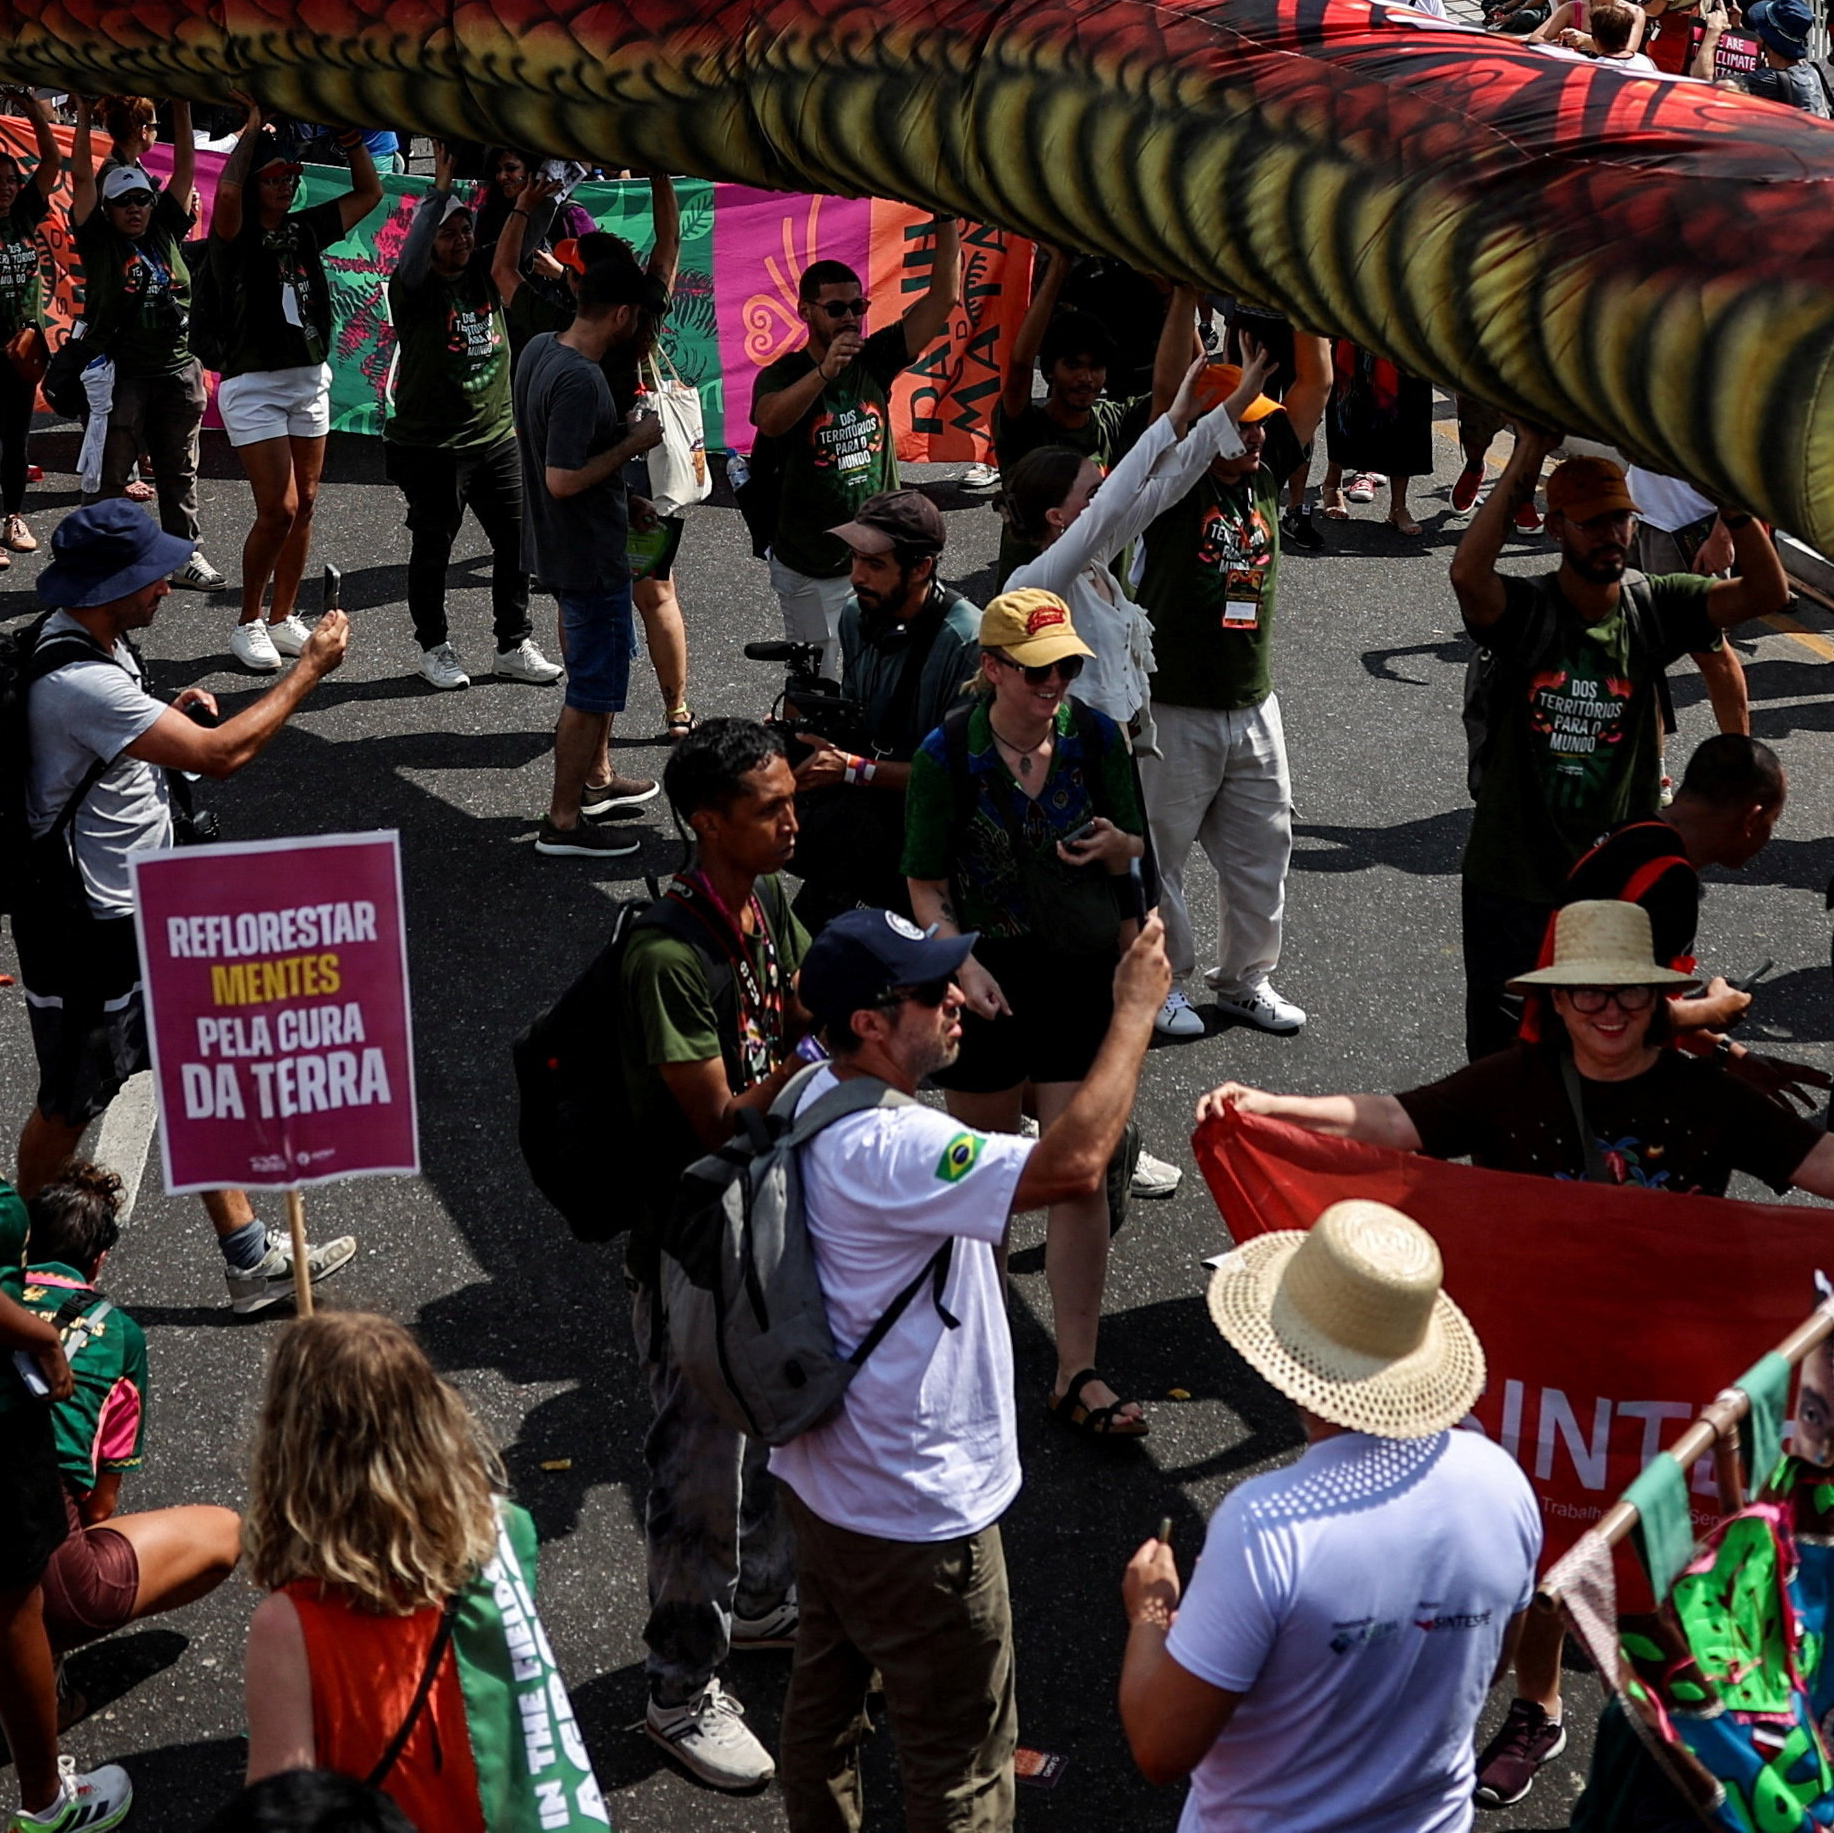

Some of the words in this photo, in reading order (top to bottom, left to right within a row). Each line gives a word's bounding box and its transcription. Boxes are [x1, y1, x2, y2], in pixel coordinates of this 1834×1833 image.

[1725, 38, 1745, 52] ARE
[1715, 50, 1757, 72] CLIMATE
[839, 409, 857, 424] DOS
[819, 417, 878, 445] TERRITÓRIOS
[836, 440, 861, 456] PARA
[860, 439, 868, 452] O
[836, 449, 872, 471] MUNDO
[1571, 678, 1599, 700] DOS
[1540, 691, 1624, 719] TERRITÓRIOS
[1555, 715, 1589, 736] PARA
[1590, 718, 1602, 737] O
[1549, 733, 1597, 754] MUNDO
[167, 900, 377, 962] REFLORESTAR
[210, 954, 341, 1007] MENTES
[197, 1012, 274, 1060] PELA
[277, 1002, 366, 1053] CURA
[181, 1061, 244, 1121] DA
[250, 1047, 392, 1119] TERRA
[1542, 1495, 1609, 1523] Trabalha
[517, 1691, 564, 1775] THE
[535, 1781, 570, 1829] IN
